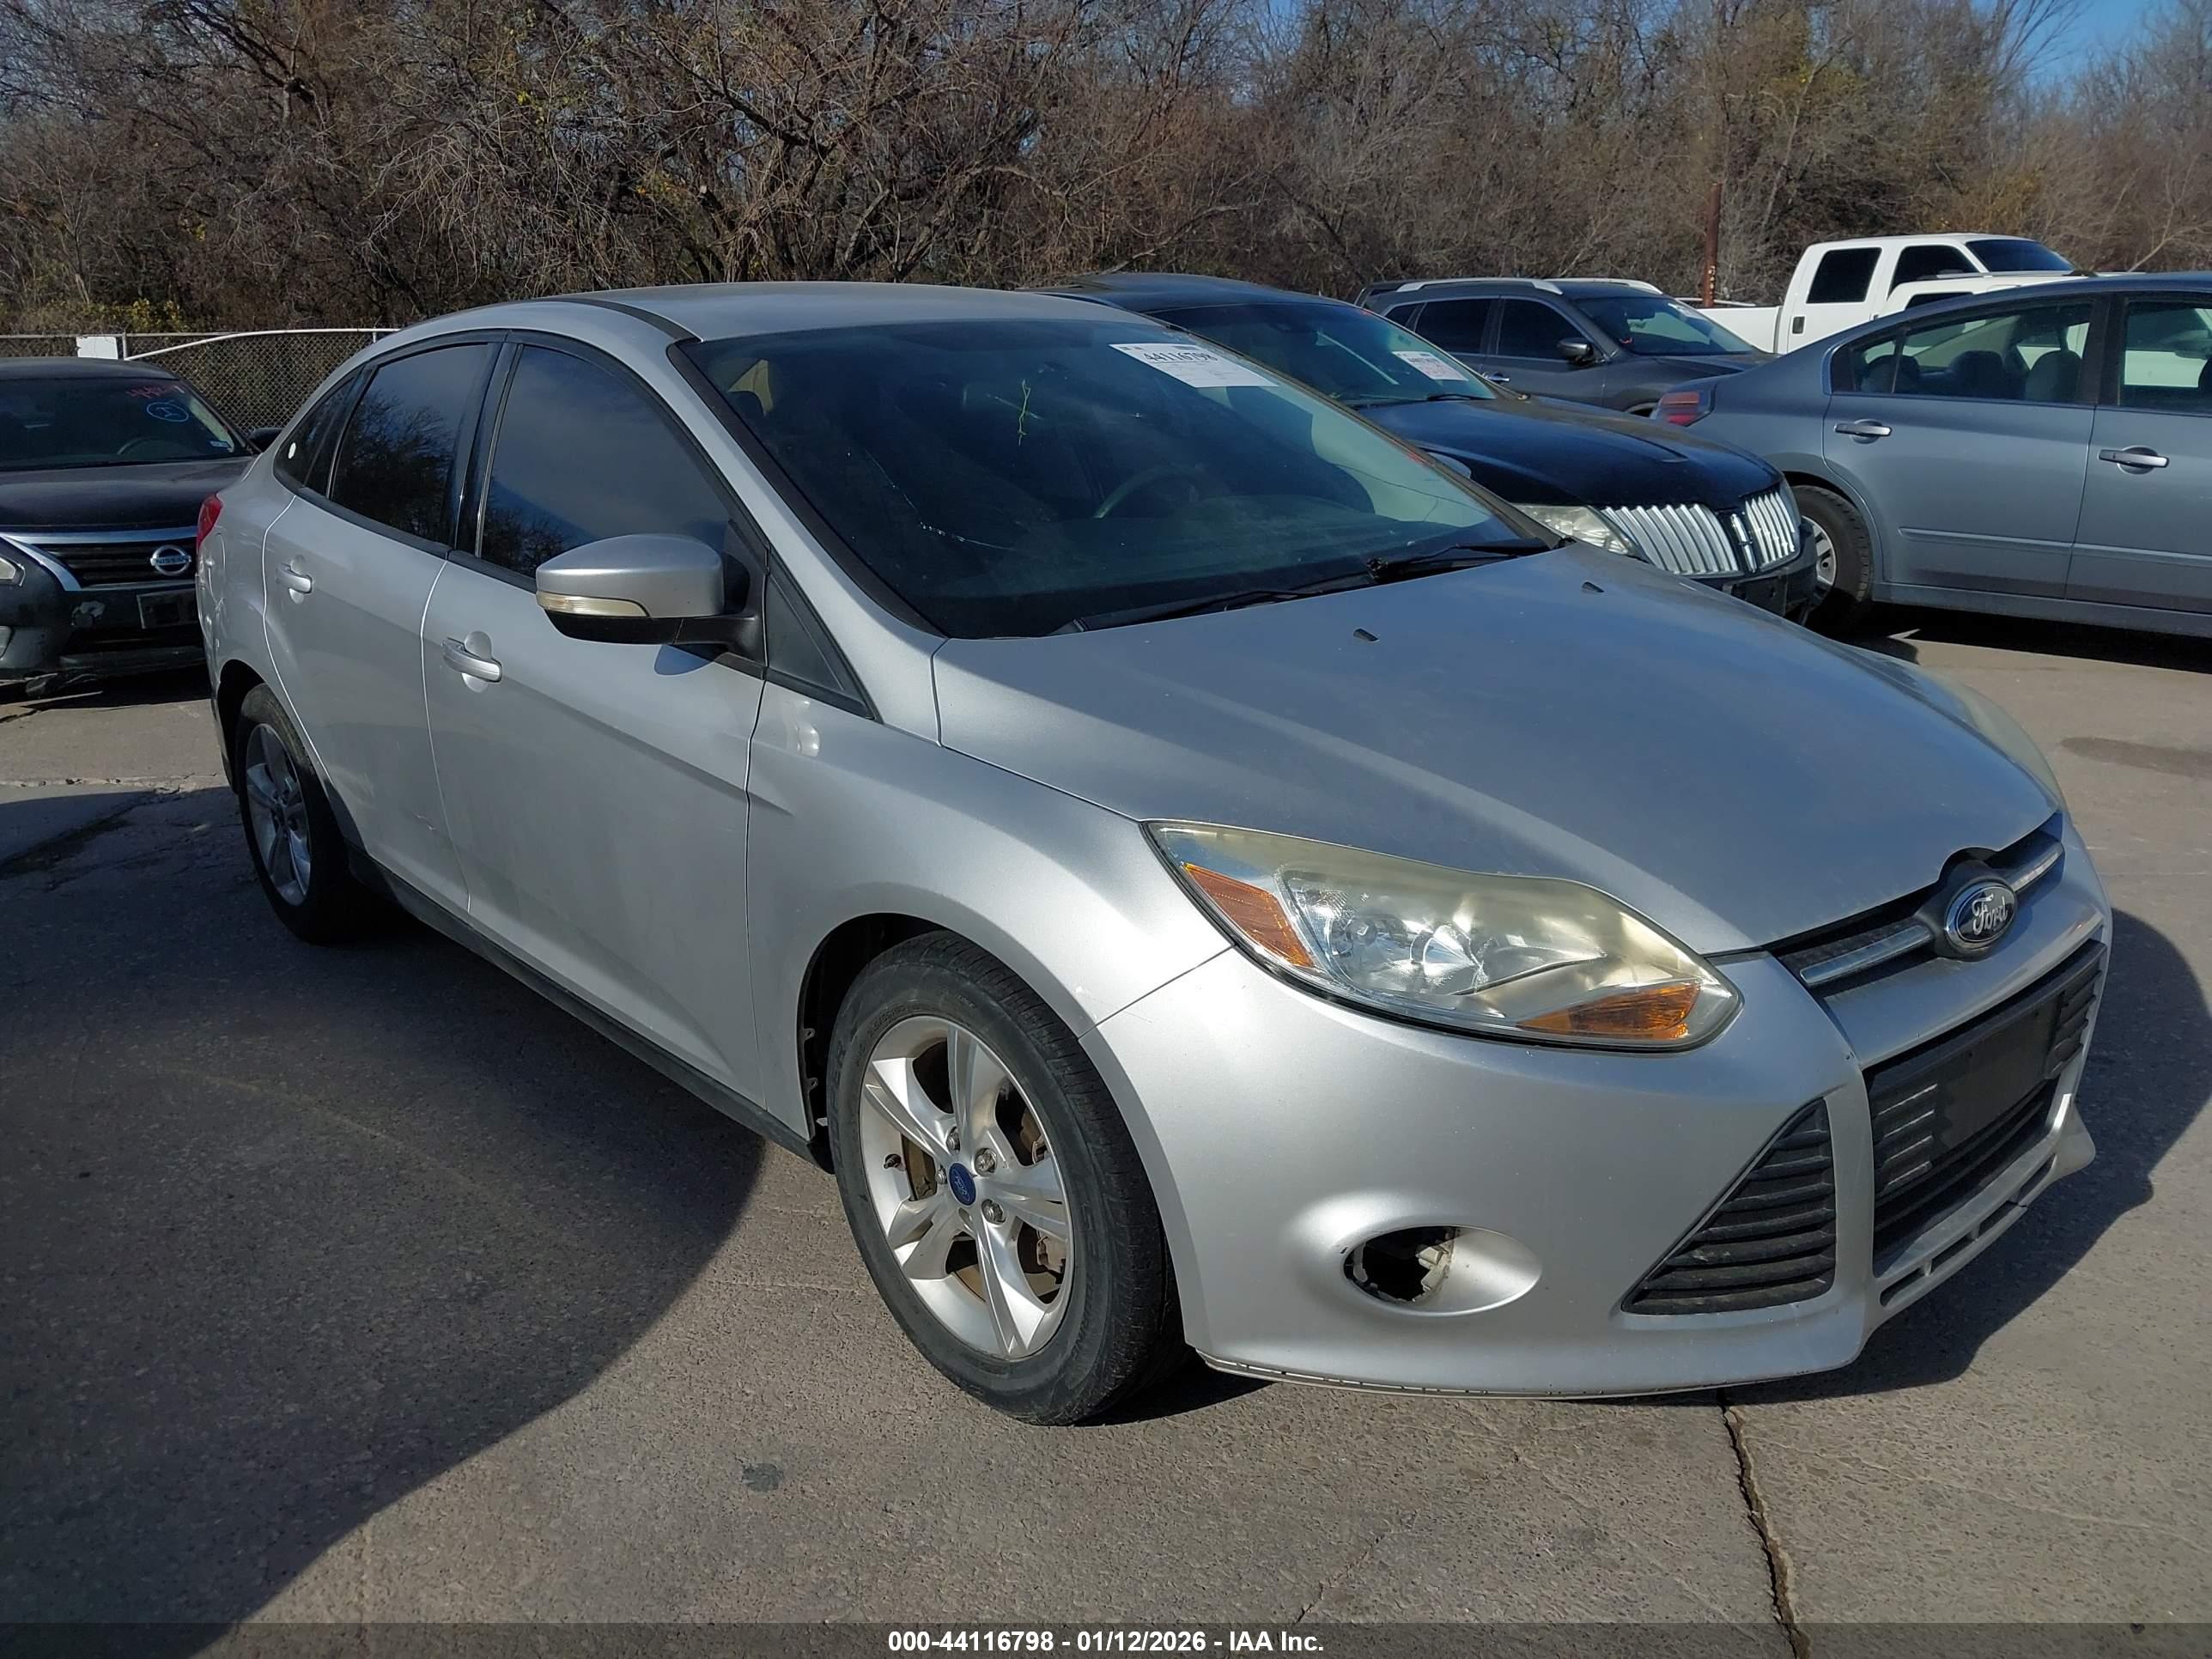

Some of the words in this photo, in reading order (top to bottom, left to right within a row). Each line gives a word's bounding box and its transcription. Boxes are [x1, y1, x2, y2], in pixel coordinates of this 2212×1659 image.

[1143, 351, 1218, 362] 44116798
[155, 556, 188, 565] NISSAN
[1972, 893, 2008, 935] Ford
